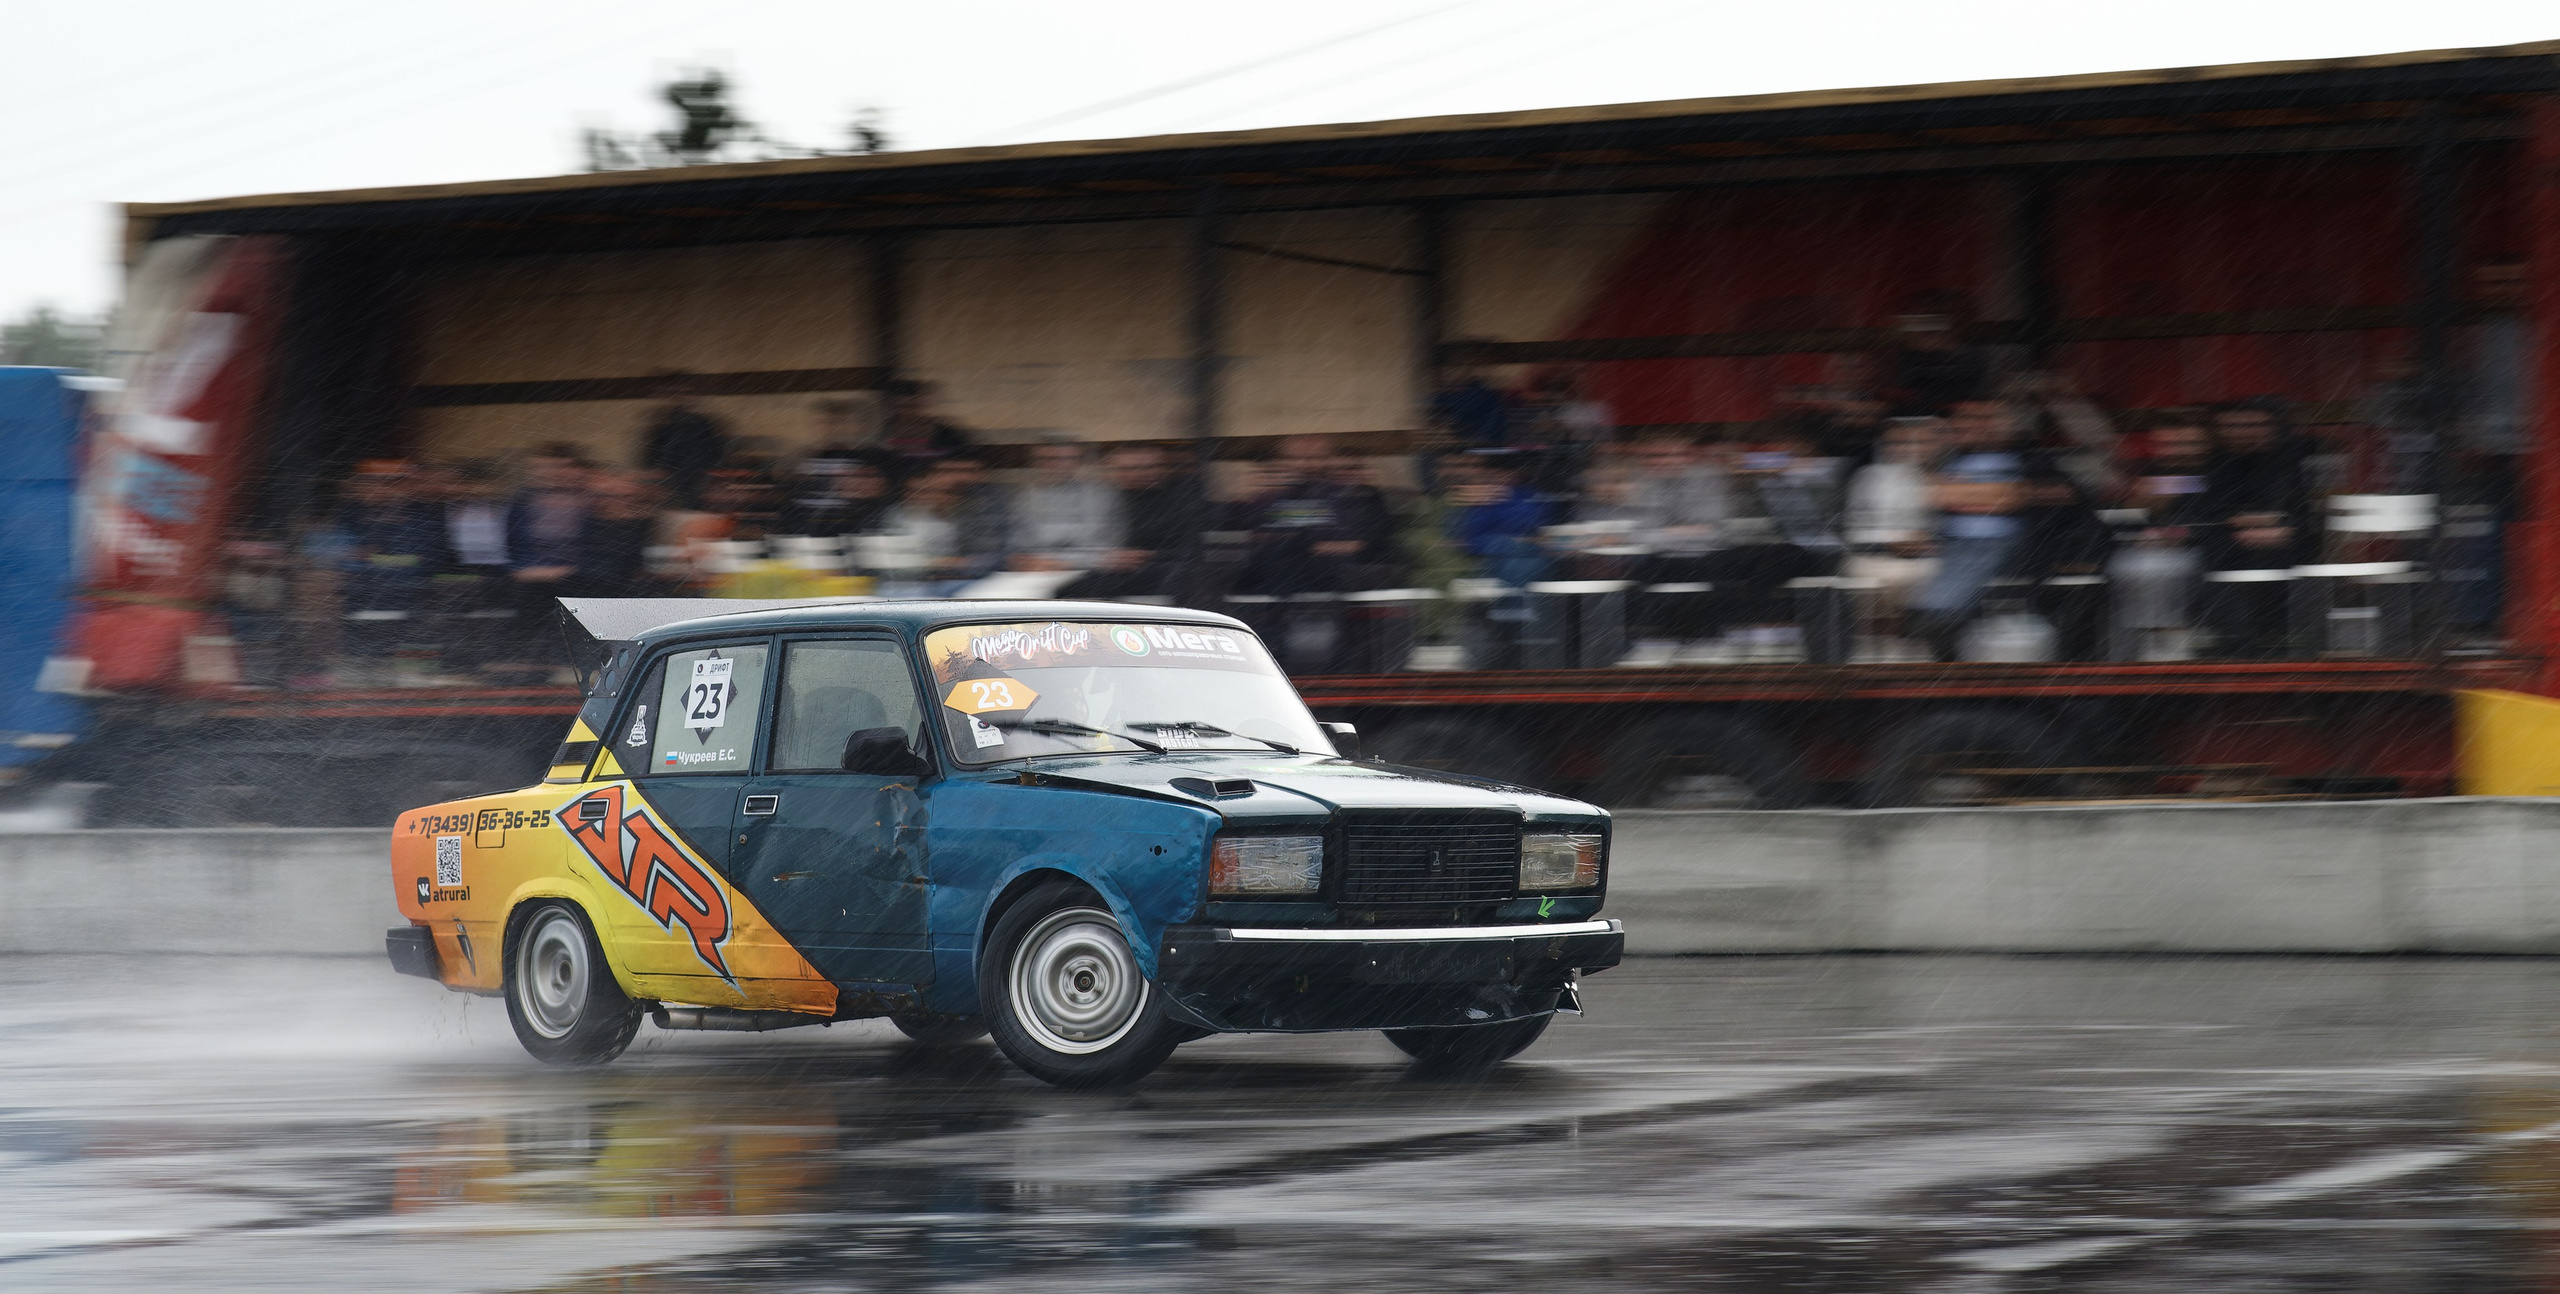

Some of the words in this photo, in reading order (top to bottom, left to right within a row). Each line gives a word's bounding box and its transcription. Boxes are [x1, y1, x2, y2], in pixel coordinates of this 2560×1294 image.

[972, 630, 1020, 664] Mega
[1015, 621, 1062, 660] Drift
[1060, 627, 1091, 655] Cup
[1144, 626, 1241, 653] Мега
[709, 662, 730, 674] ДРИФТ
[691, 683, 723, 720] 23
[971, 681, 1014, 709] 23
[678, 750, 717, 765] Чукреев
[479, 810, 551, 830] 36-36-25
[433, 886, 470, 902] atrural
